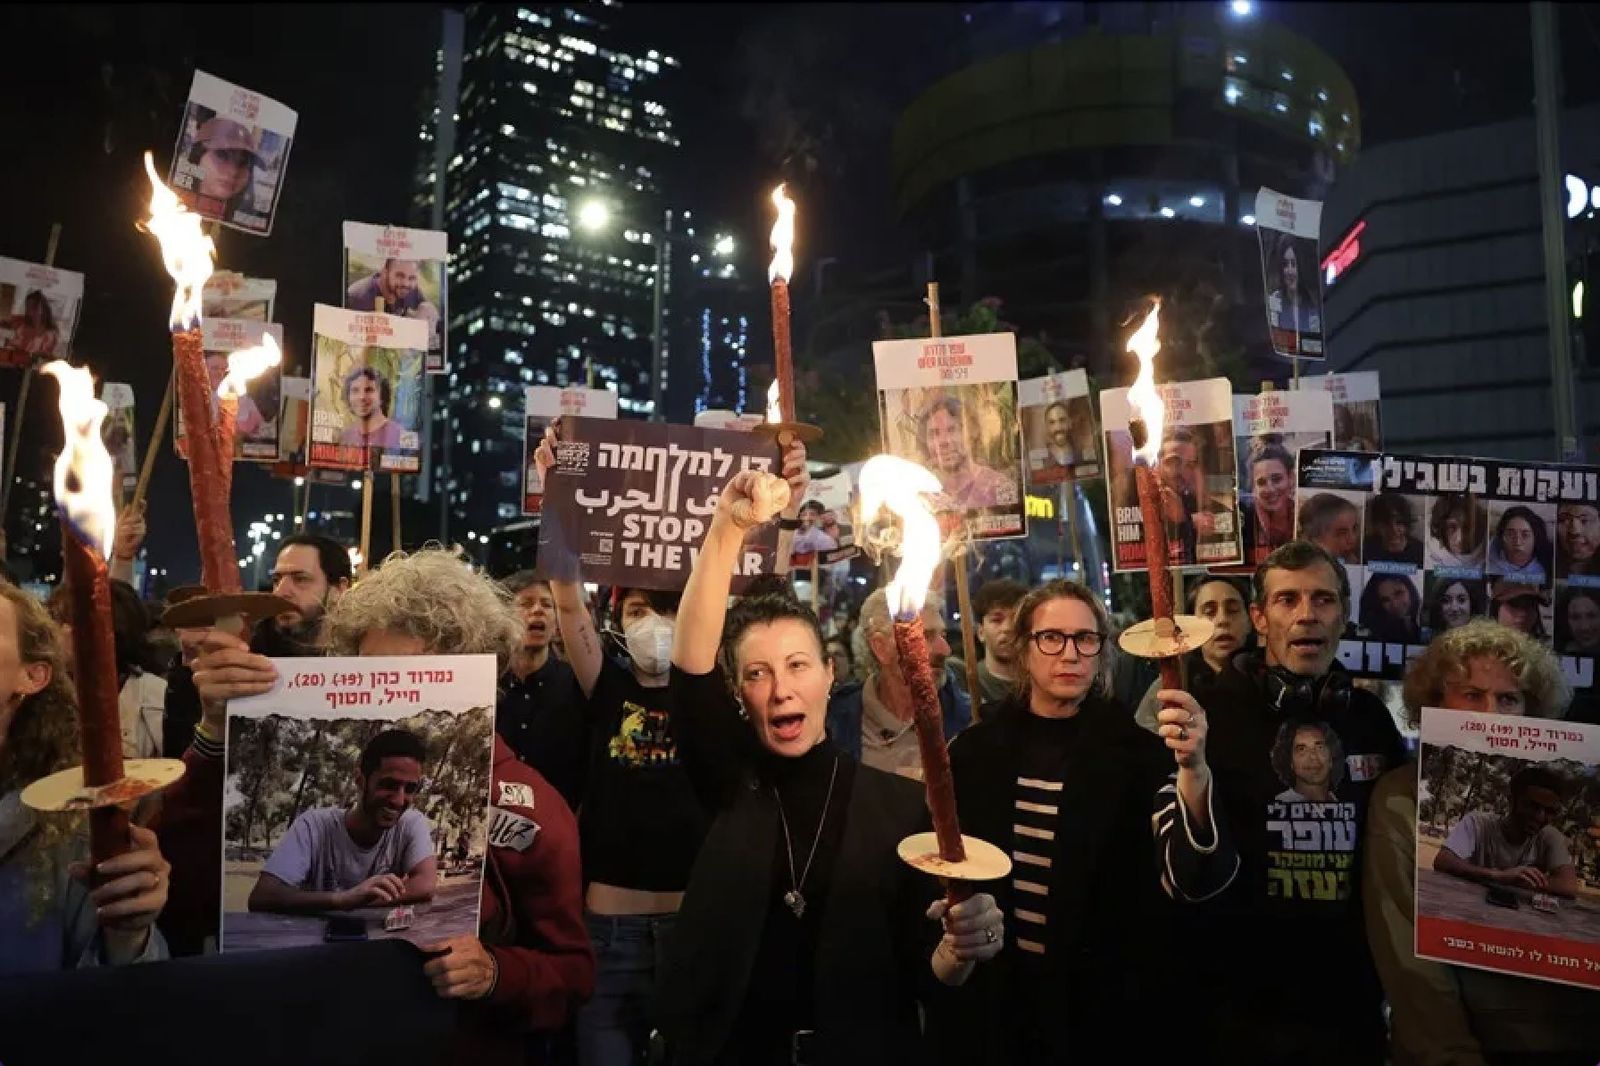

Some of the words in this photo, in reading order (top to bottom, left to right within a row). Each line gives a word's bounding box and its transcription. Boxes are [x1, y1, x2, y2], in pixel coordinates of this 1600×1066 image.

[597, 442, 733, 480] למלחמה
[574, 477, 681, 517] الحرب
[621, 513, 704, 543] STOP
[620, 541, 683, 570] THE
[370, 671, 400, 688] כהן
[407, 670, 454, 685] נמרוד
[326, 690, 371, 709] חטוף
[378, 688, 421, 706] חייל,
[1517, 725, 1540, 738] כהן
[1546, 728, 1585, 742] נמרוד
[1486, 736, 1519, 749] חטוף
[1267, 802, 1287, 818] לי
[1291, 802, 1356, 820] קוראים
[1266, 820, 1357, 851] עופר
[1442, 936, 1475, 950] בשבי
[1477, 941, 1525, 958] להשאר
[1528, 949, 1543, 962] לו
